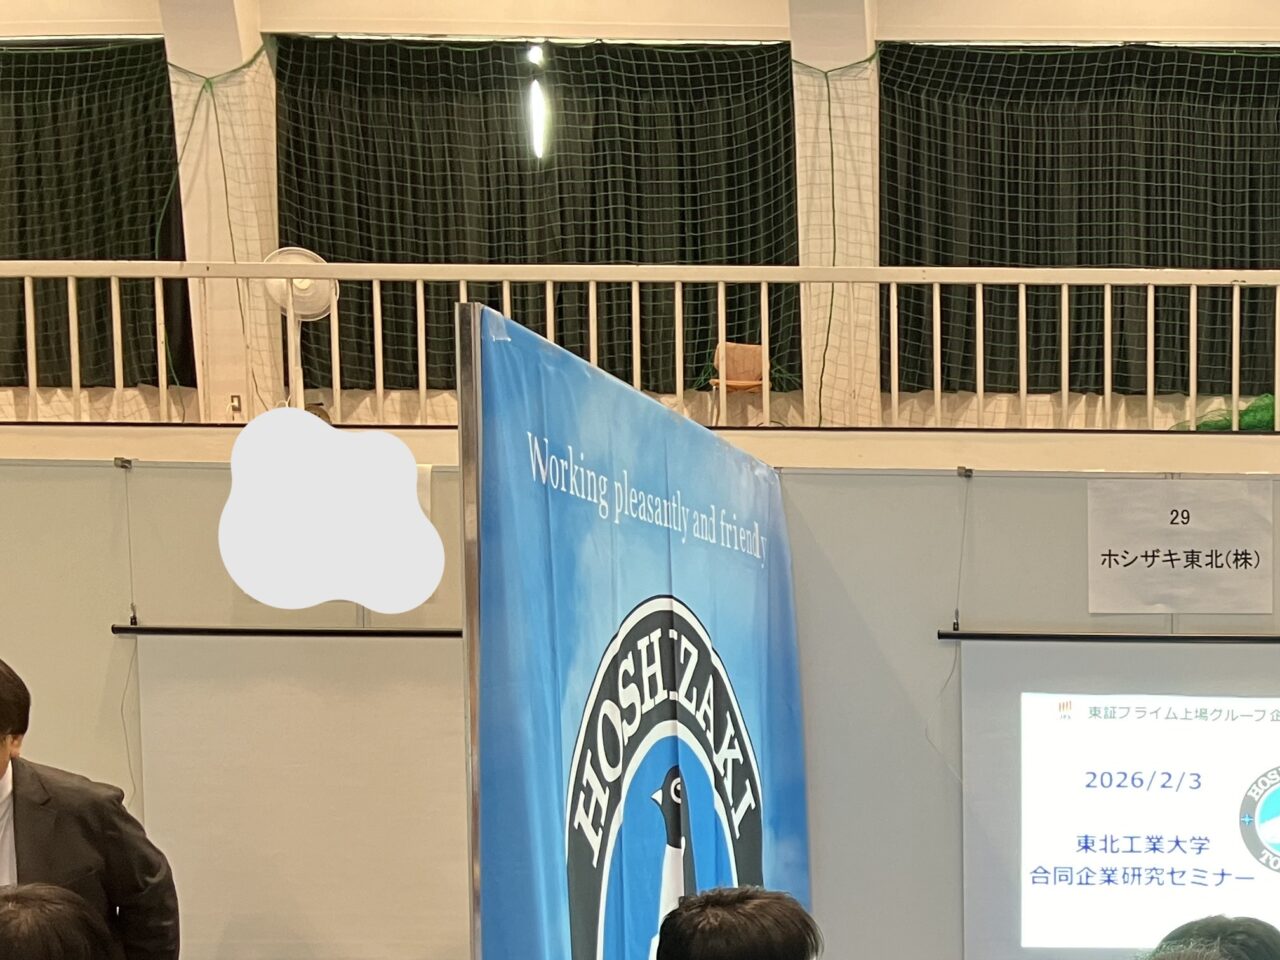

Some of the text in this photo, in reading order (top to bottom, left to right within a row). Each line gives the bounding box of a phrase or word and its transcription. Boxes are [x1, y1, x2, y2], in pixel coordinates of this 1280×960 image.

[527, 431, 608, 519] Working
[614, 470, 689, 544] pleasantly
[693, 505, 716, 544] and
[1169, 509, 1191, 525] 29
[1100, 549, 1260, 570] ホシザキ東北(株)
[1085, 771, 1202, 792] 2026/2/3
[1076, 834, 1210, 855] 東北工業大学
[1030, 866, 1255, 887] 合同企業研究セミナー
